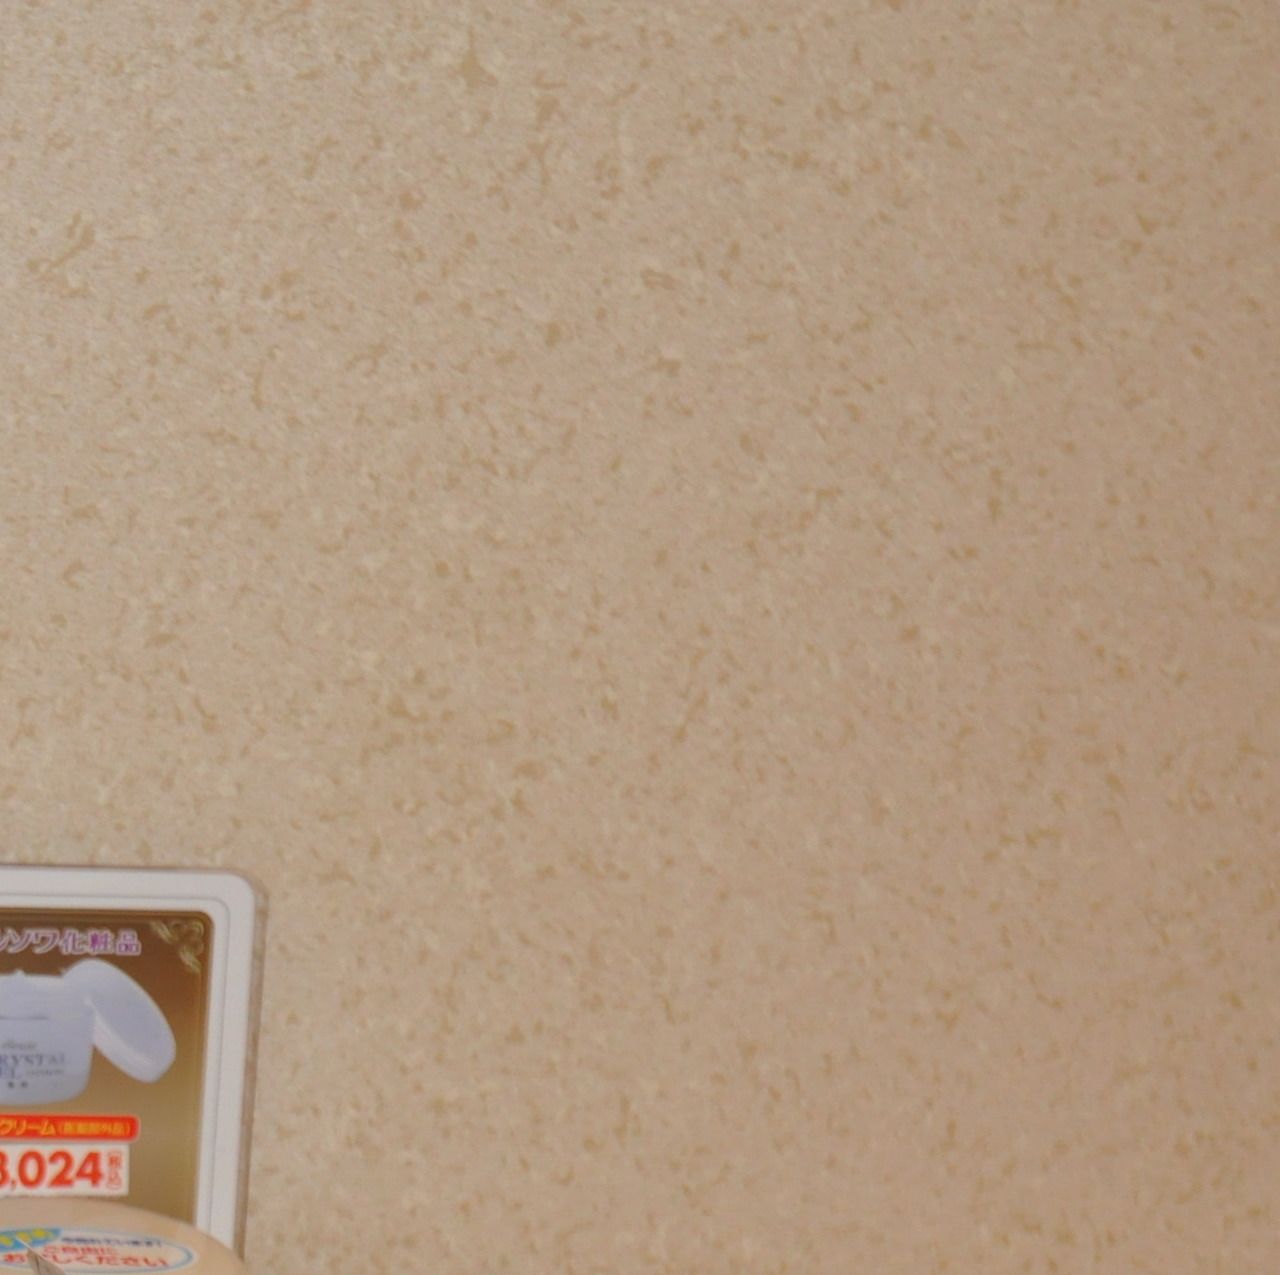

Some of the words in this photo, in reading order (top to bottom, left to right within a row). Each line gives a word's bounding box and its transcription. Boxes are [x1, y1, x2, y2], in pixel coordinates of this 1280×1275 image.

[2, 1250, 171, 1268] おしください
